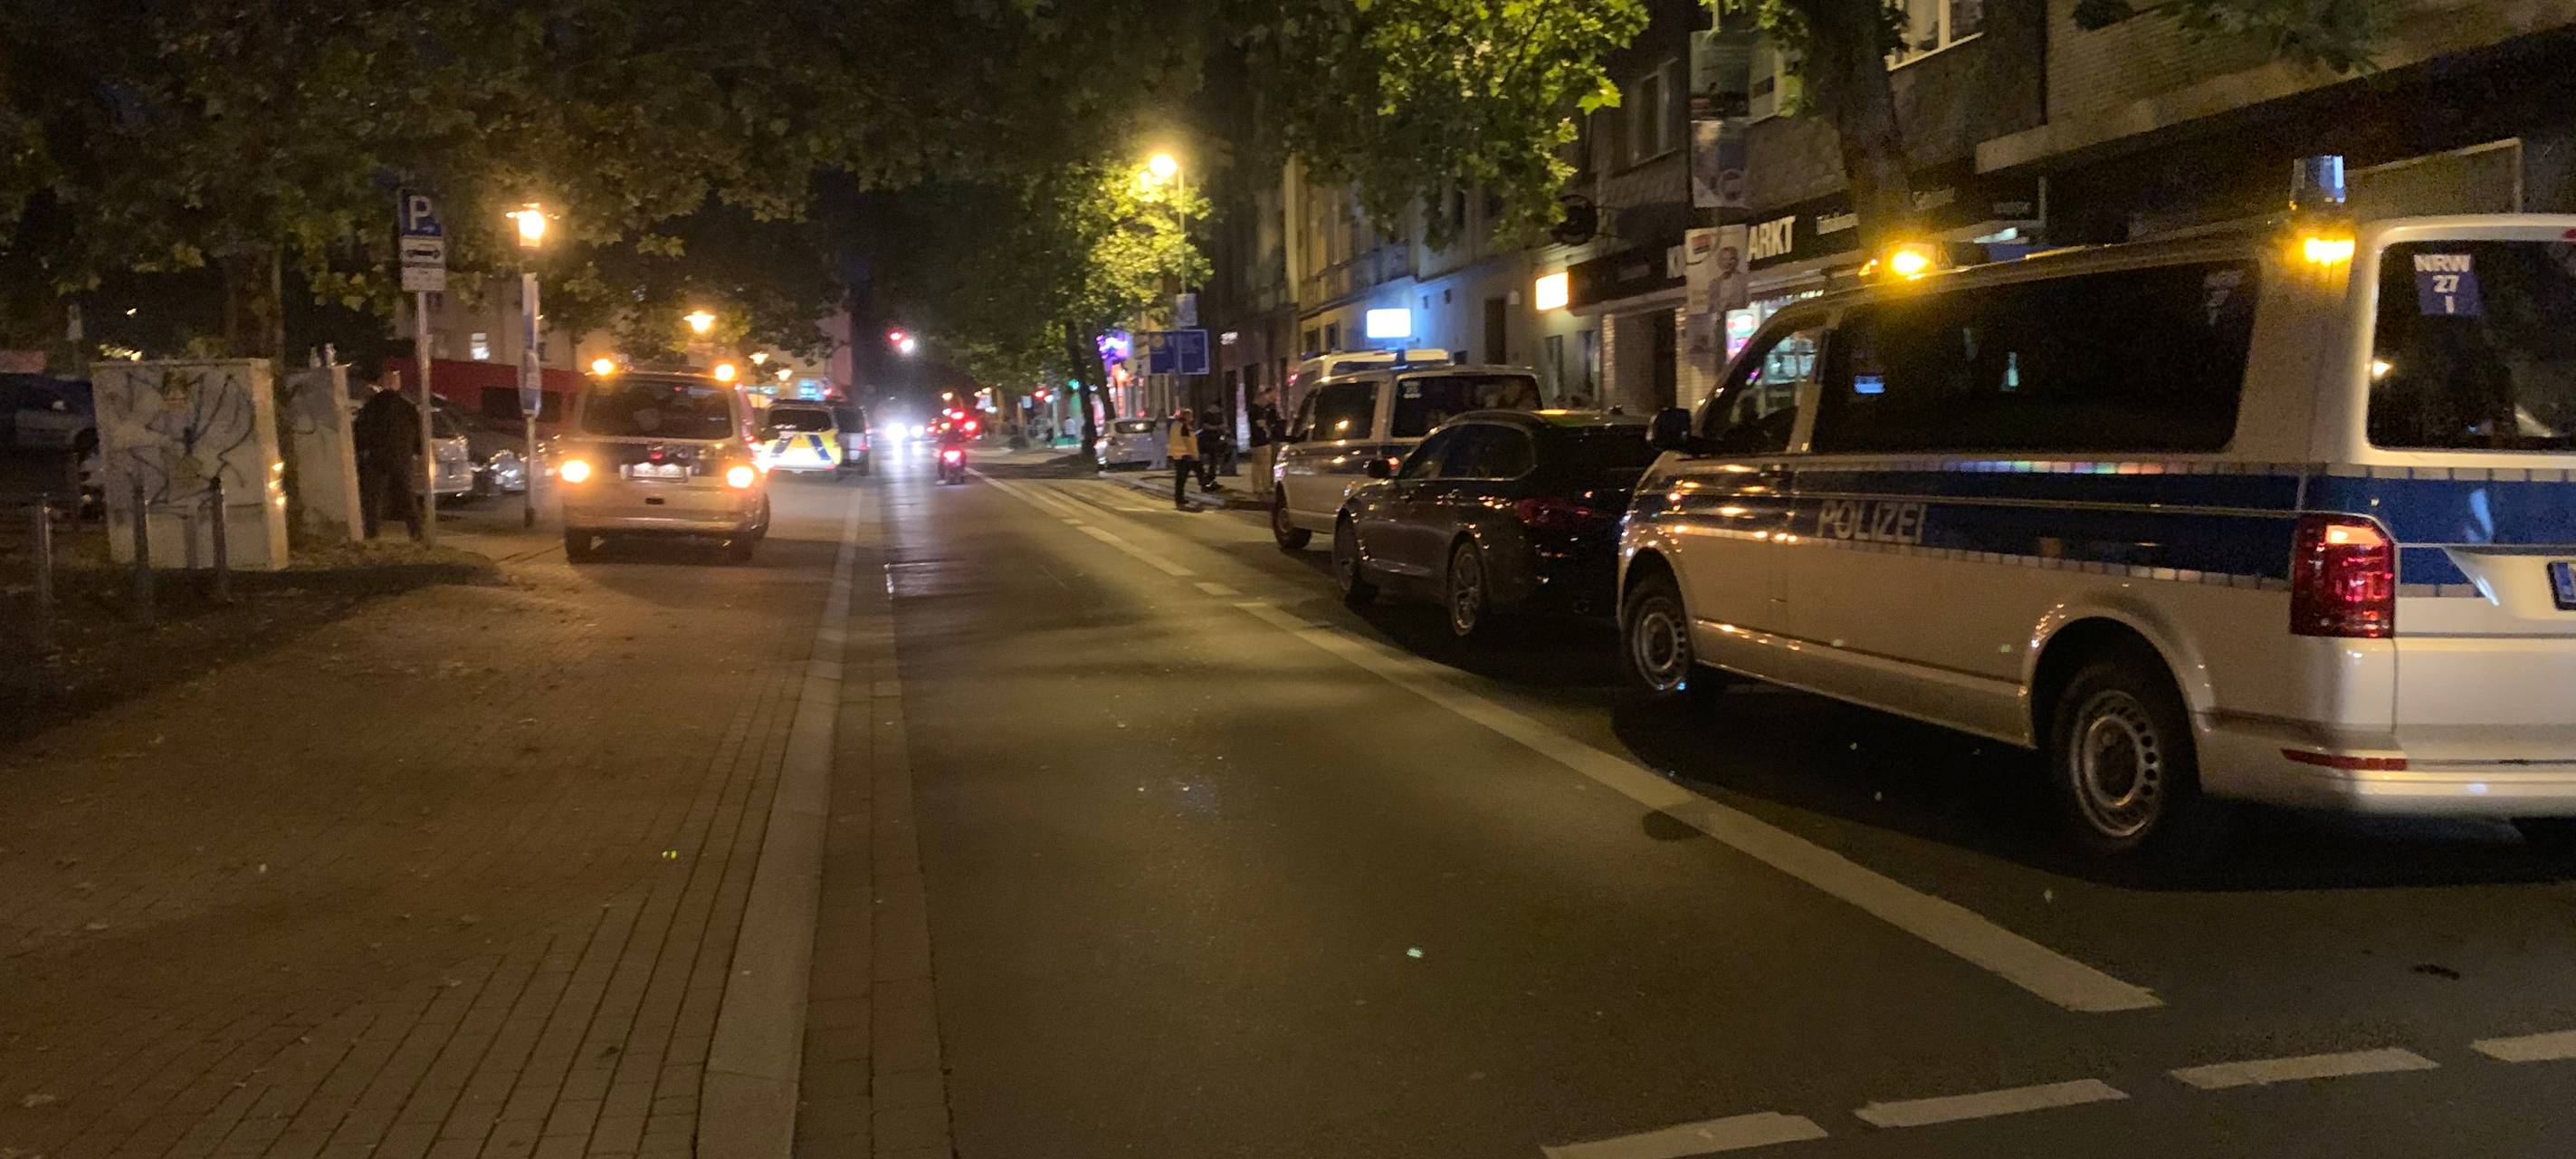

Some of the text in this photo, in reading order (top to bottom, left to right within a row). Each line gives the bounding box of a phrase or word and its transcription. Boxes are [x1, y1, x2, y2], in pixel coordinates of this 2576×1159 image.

[408, 195, 432, 230] P
[1746, 215, 1797, 263] ARKT
[2413, 254, 2471, 273] NRW
[2432, 274, 2460, 292] 27
[1818, 499, 1927, 544] POLIZEI
